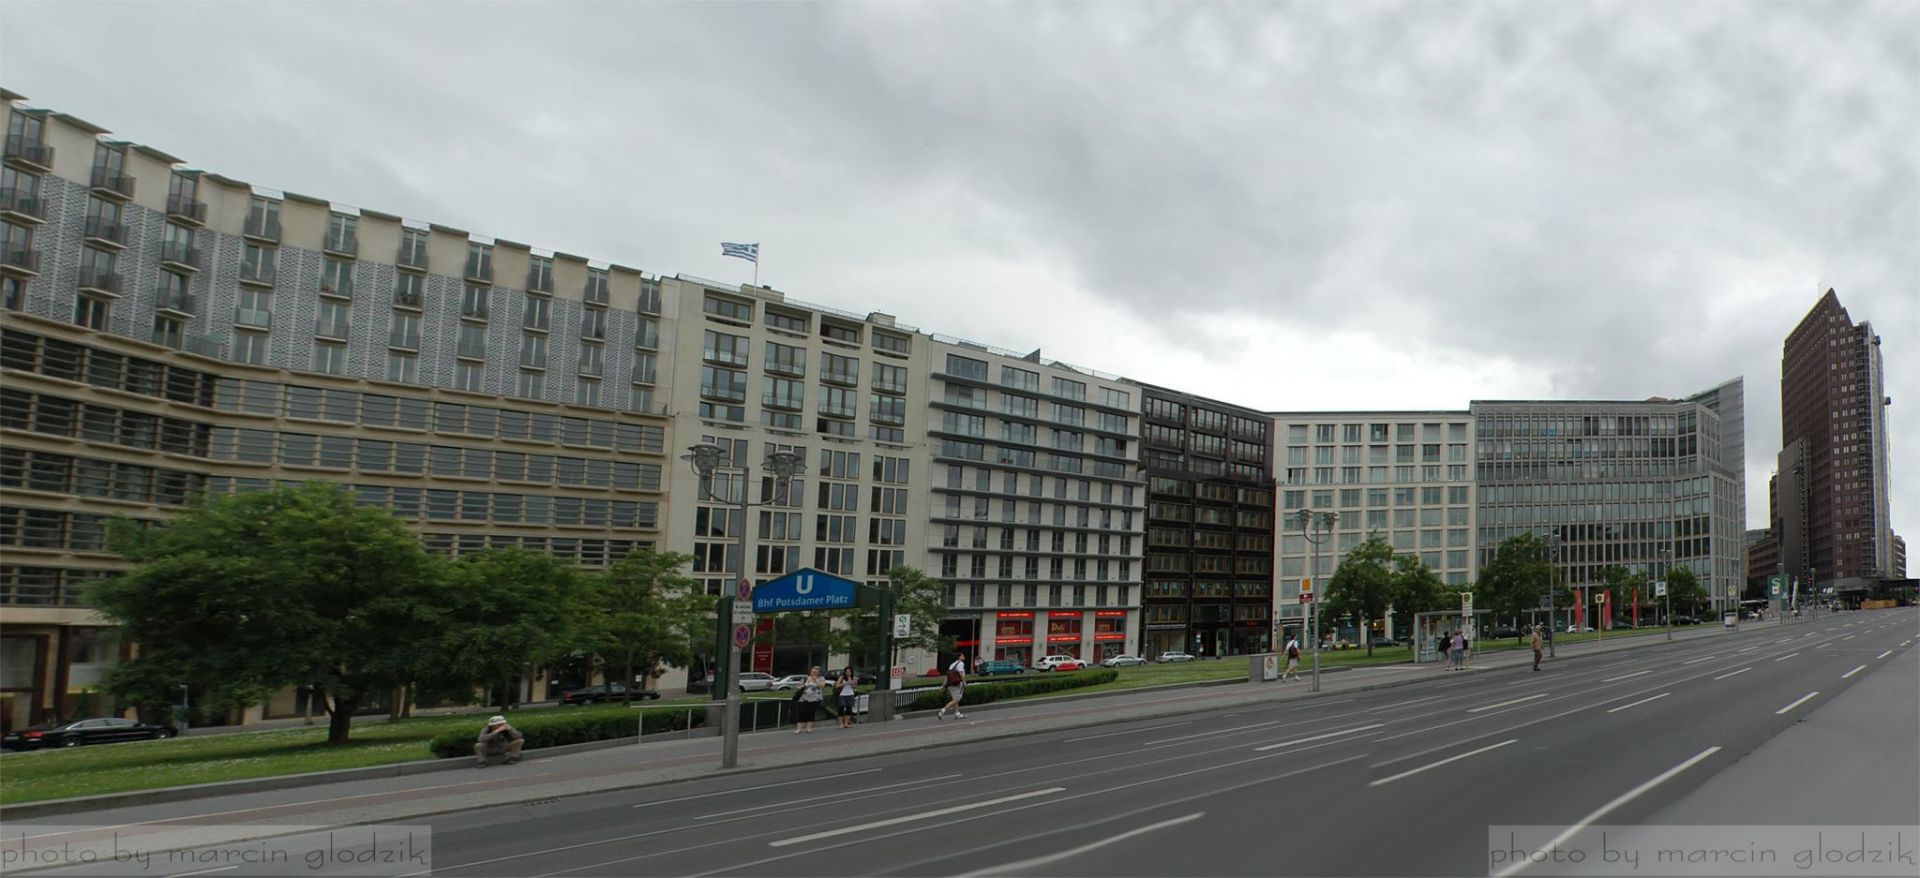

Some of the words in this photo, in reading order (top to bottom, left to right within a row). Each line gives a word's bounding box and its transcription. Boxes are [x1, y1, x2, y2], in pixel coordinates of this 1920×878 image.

[796, 575, 814, 594] U
[757, 598, 774, 608] Bhf
[776, 596, 825, 607] Potsdamer
[826, 595, 849, 604] Platz
